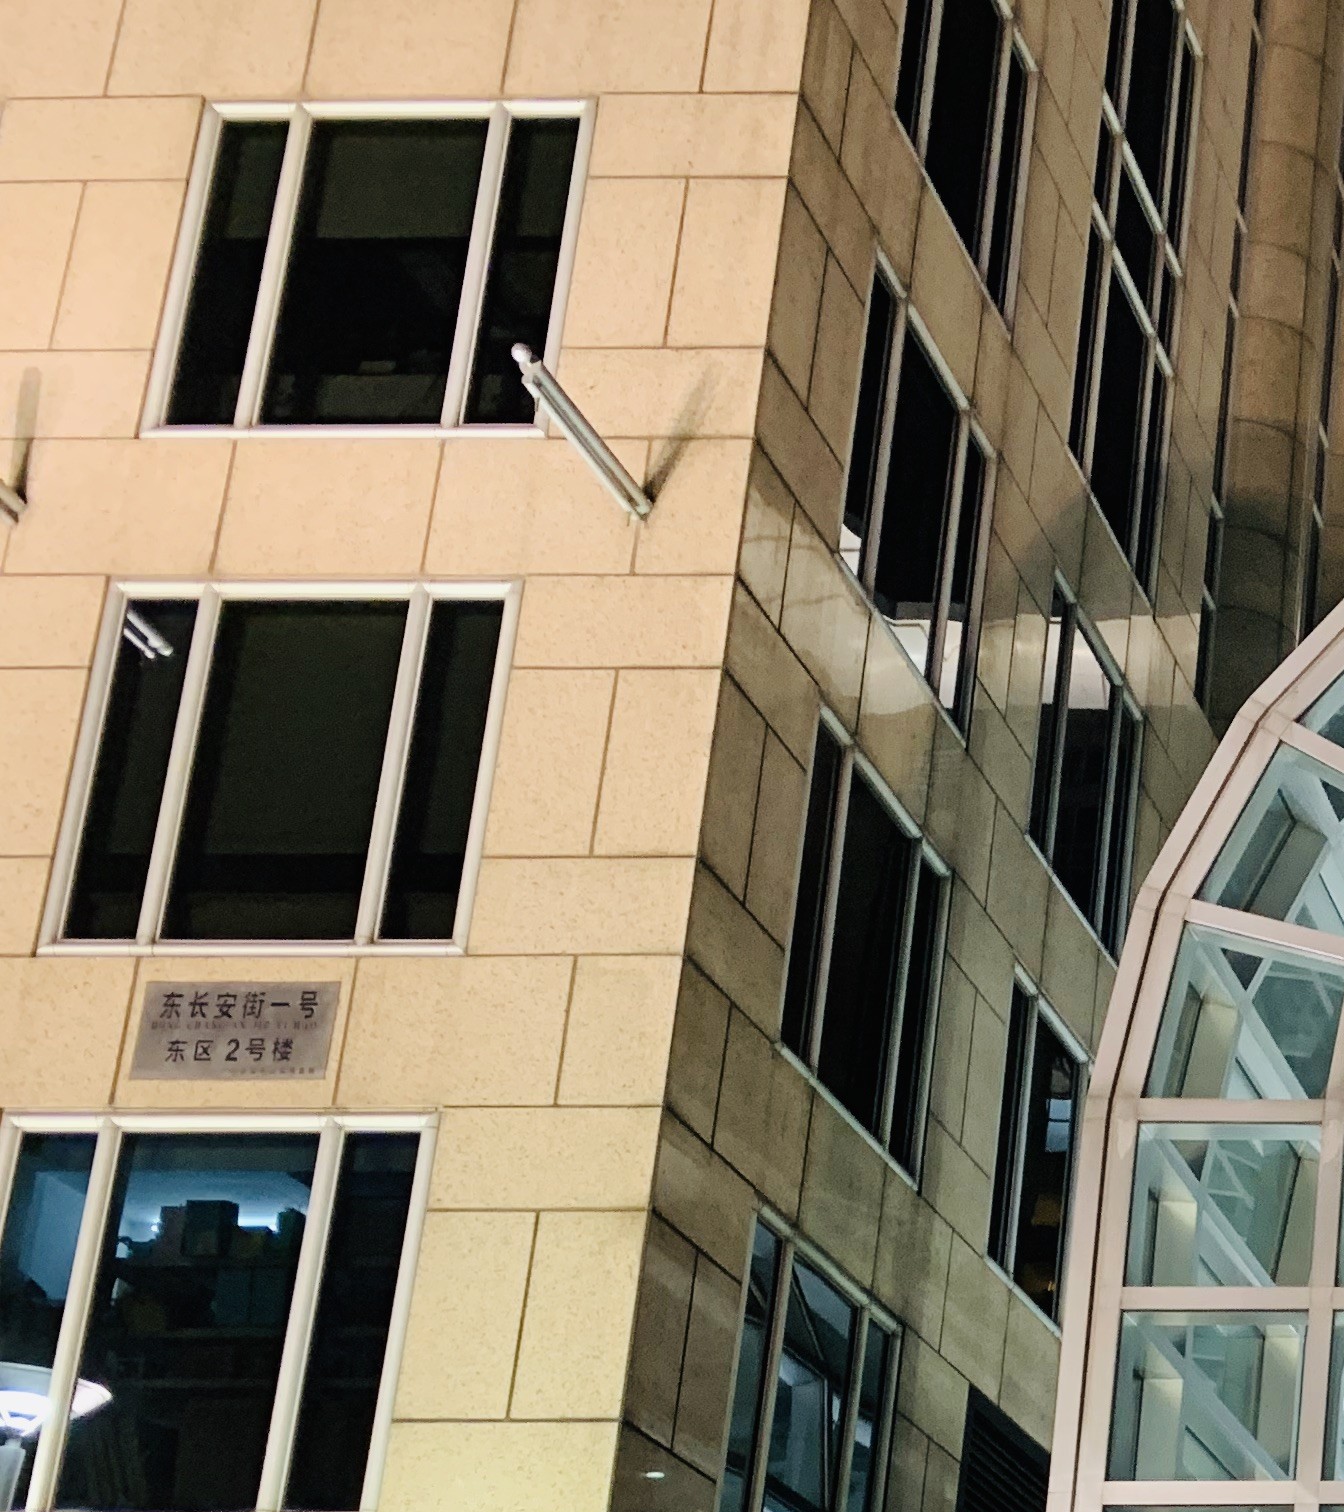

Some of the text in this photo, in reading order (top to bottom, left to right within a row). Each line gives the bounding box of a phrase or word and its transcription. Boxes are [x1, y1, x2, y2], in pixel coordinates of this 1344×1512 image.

[159, 991, 319, 1019] 东长安街一号
